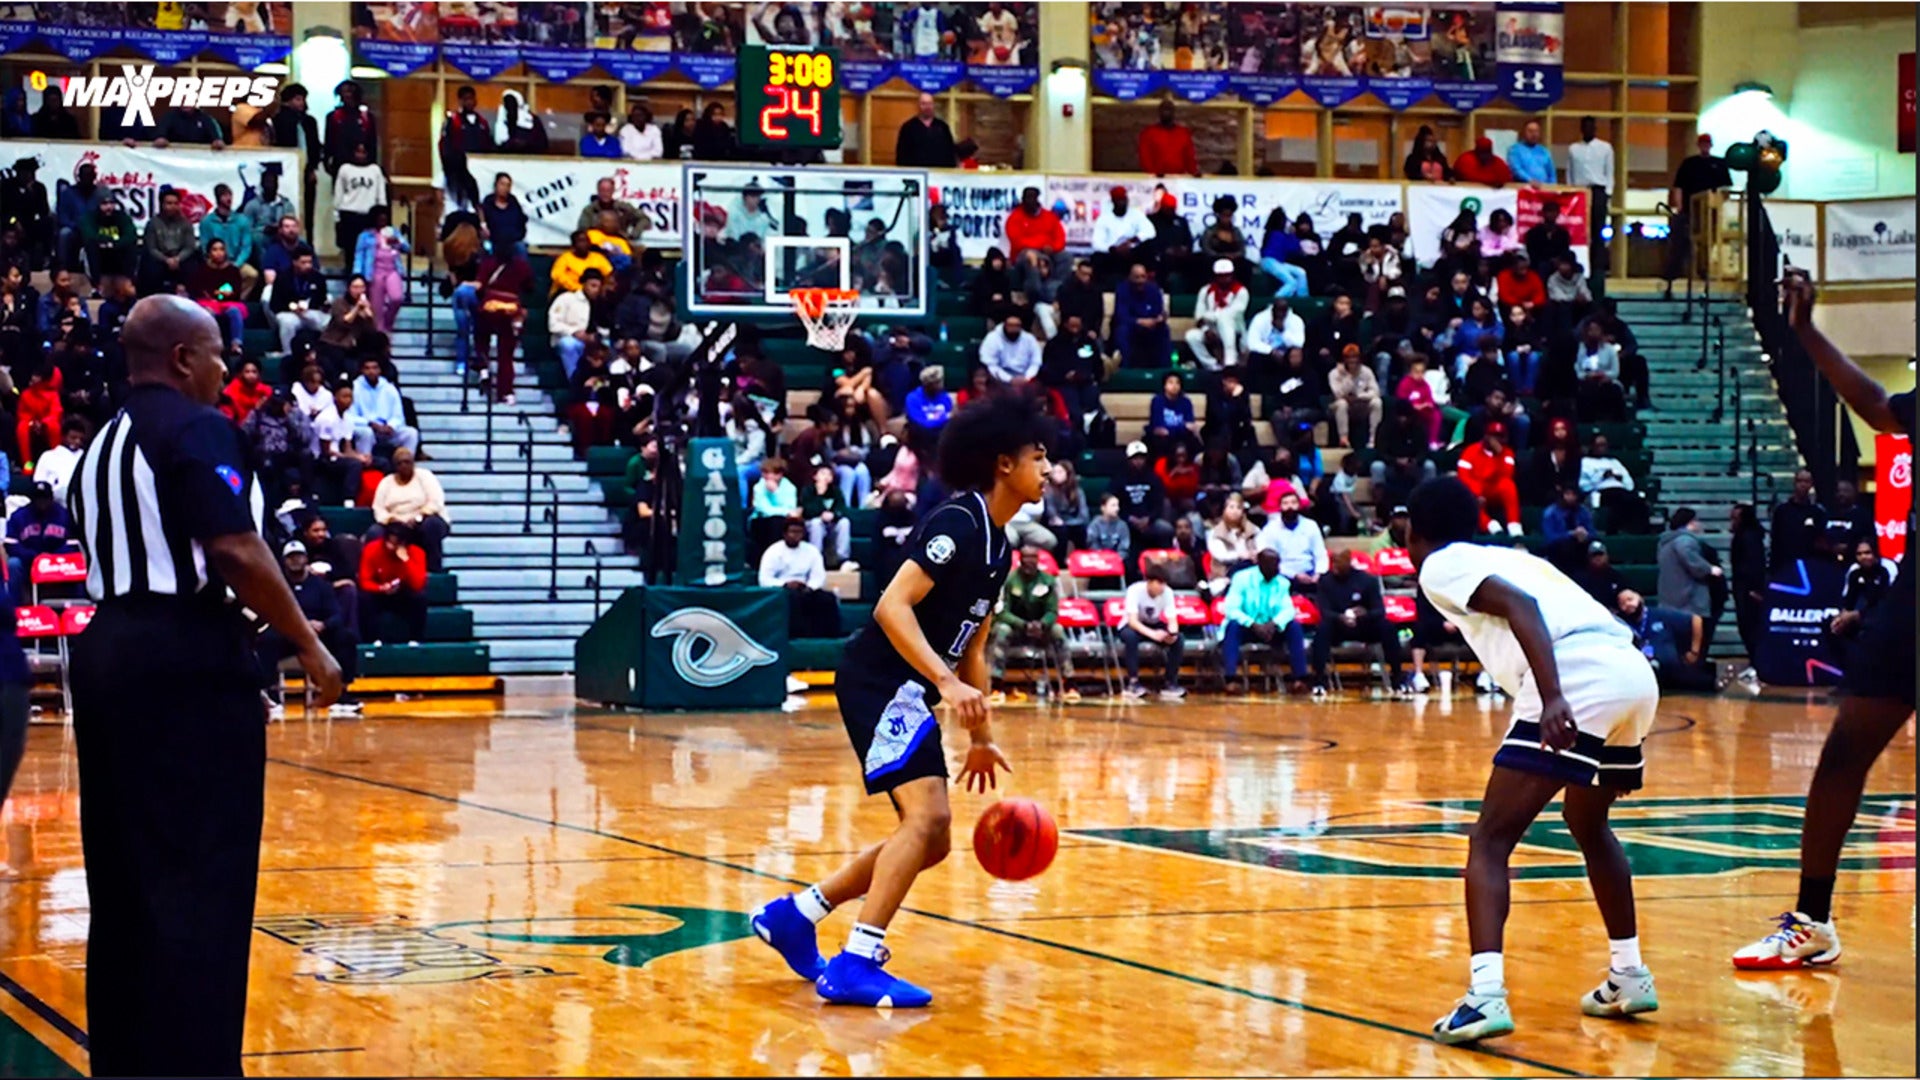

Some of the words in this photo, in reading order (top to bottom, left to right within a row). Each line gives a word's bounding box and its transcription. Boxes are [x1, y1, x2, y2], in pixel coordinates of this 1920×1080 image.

[769, 52, 833, 88] 3:08
[760, 84, 822, 139] 24
[525, 173, 577, 203] COME
[1183, 192, 1258, 209] BUR
[947, 213, 1002, 238] PORTS
[701, 447, 728, 585] GATORS
